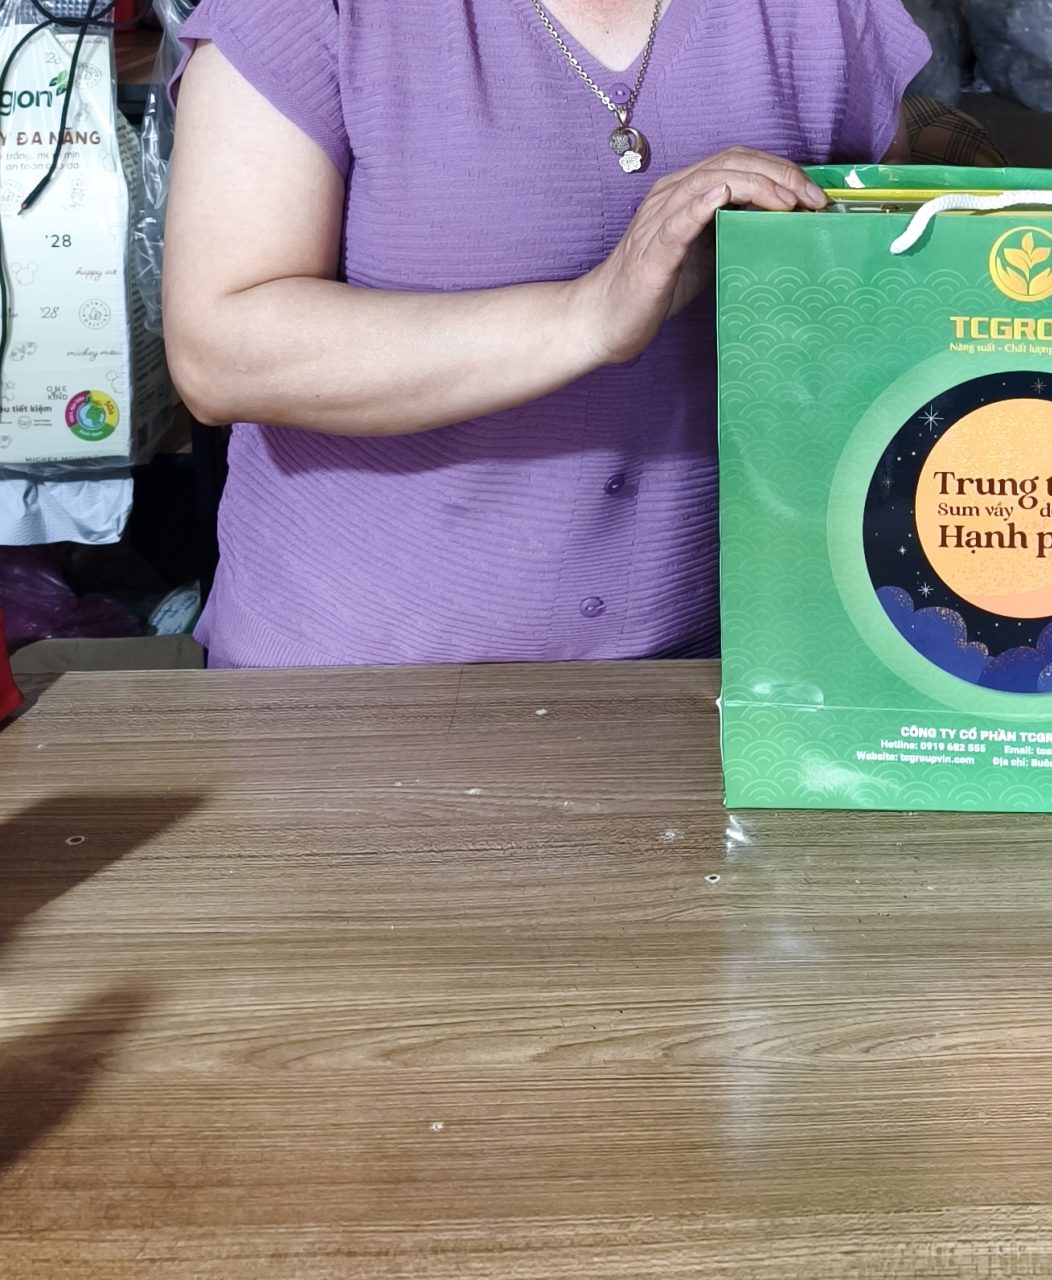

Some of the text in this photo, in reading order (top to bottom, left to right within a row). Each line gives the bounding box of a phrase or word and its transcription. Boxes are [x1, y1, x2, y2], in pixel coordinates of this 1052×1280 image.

[950, 342, 975, 353] Năng
[1004, 342, 1027, 353] Chất
[933, 471, 1040, 510] Trung
[938, 502, 980, 517] Sum
[938, 522, 1028, 554] Hạnh
[900, 725, 937, 739] CÔNG
[939, 728, 957, 739] TY
[980, 728, 1017, 742] PHẦN
[880, 740, 918, 750] Hotline:
[920, 742, 945, 751] 0919
[967, 744, 986, 753] 555
[1004, 745, 1034, 755] Email:
[856, 751, 899, 762] Website:
[900, 754, 975, 765] tcgroupvin.com
